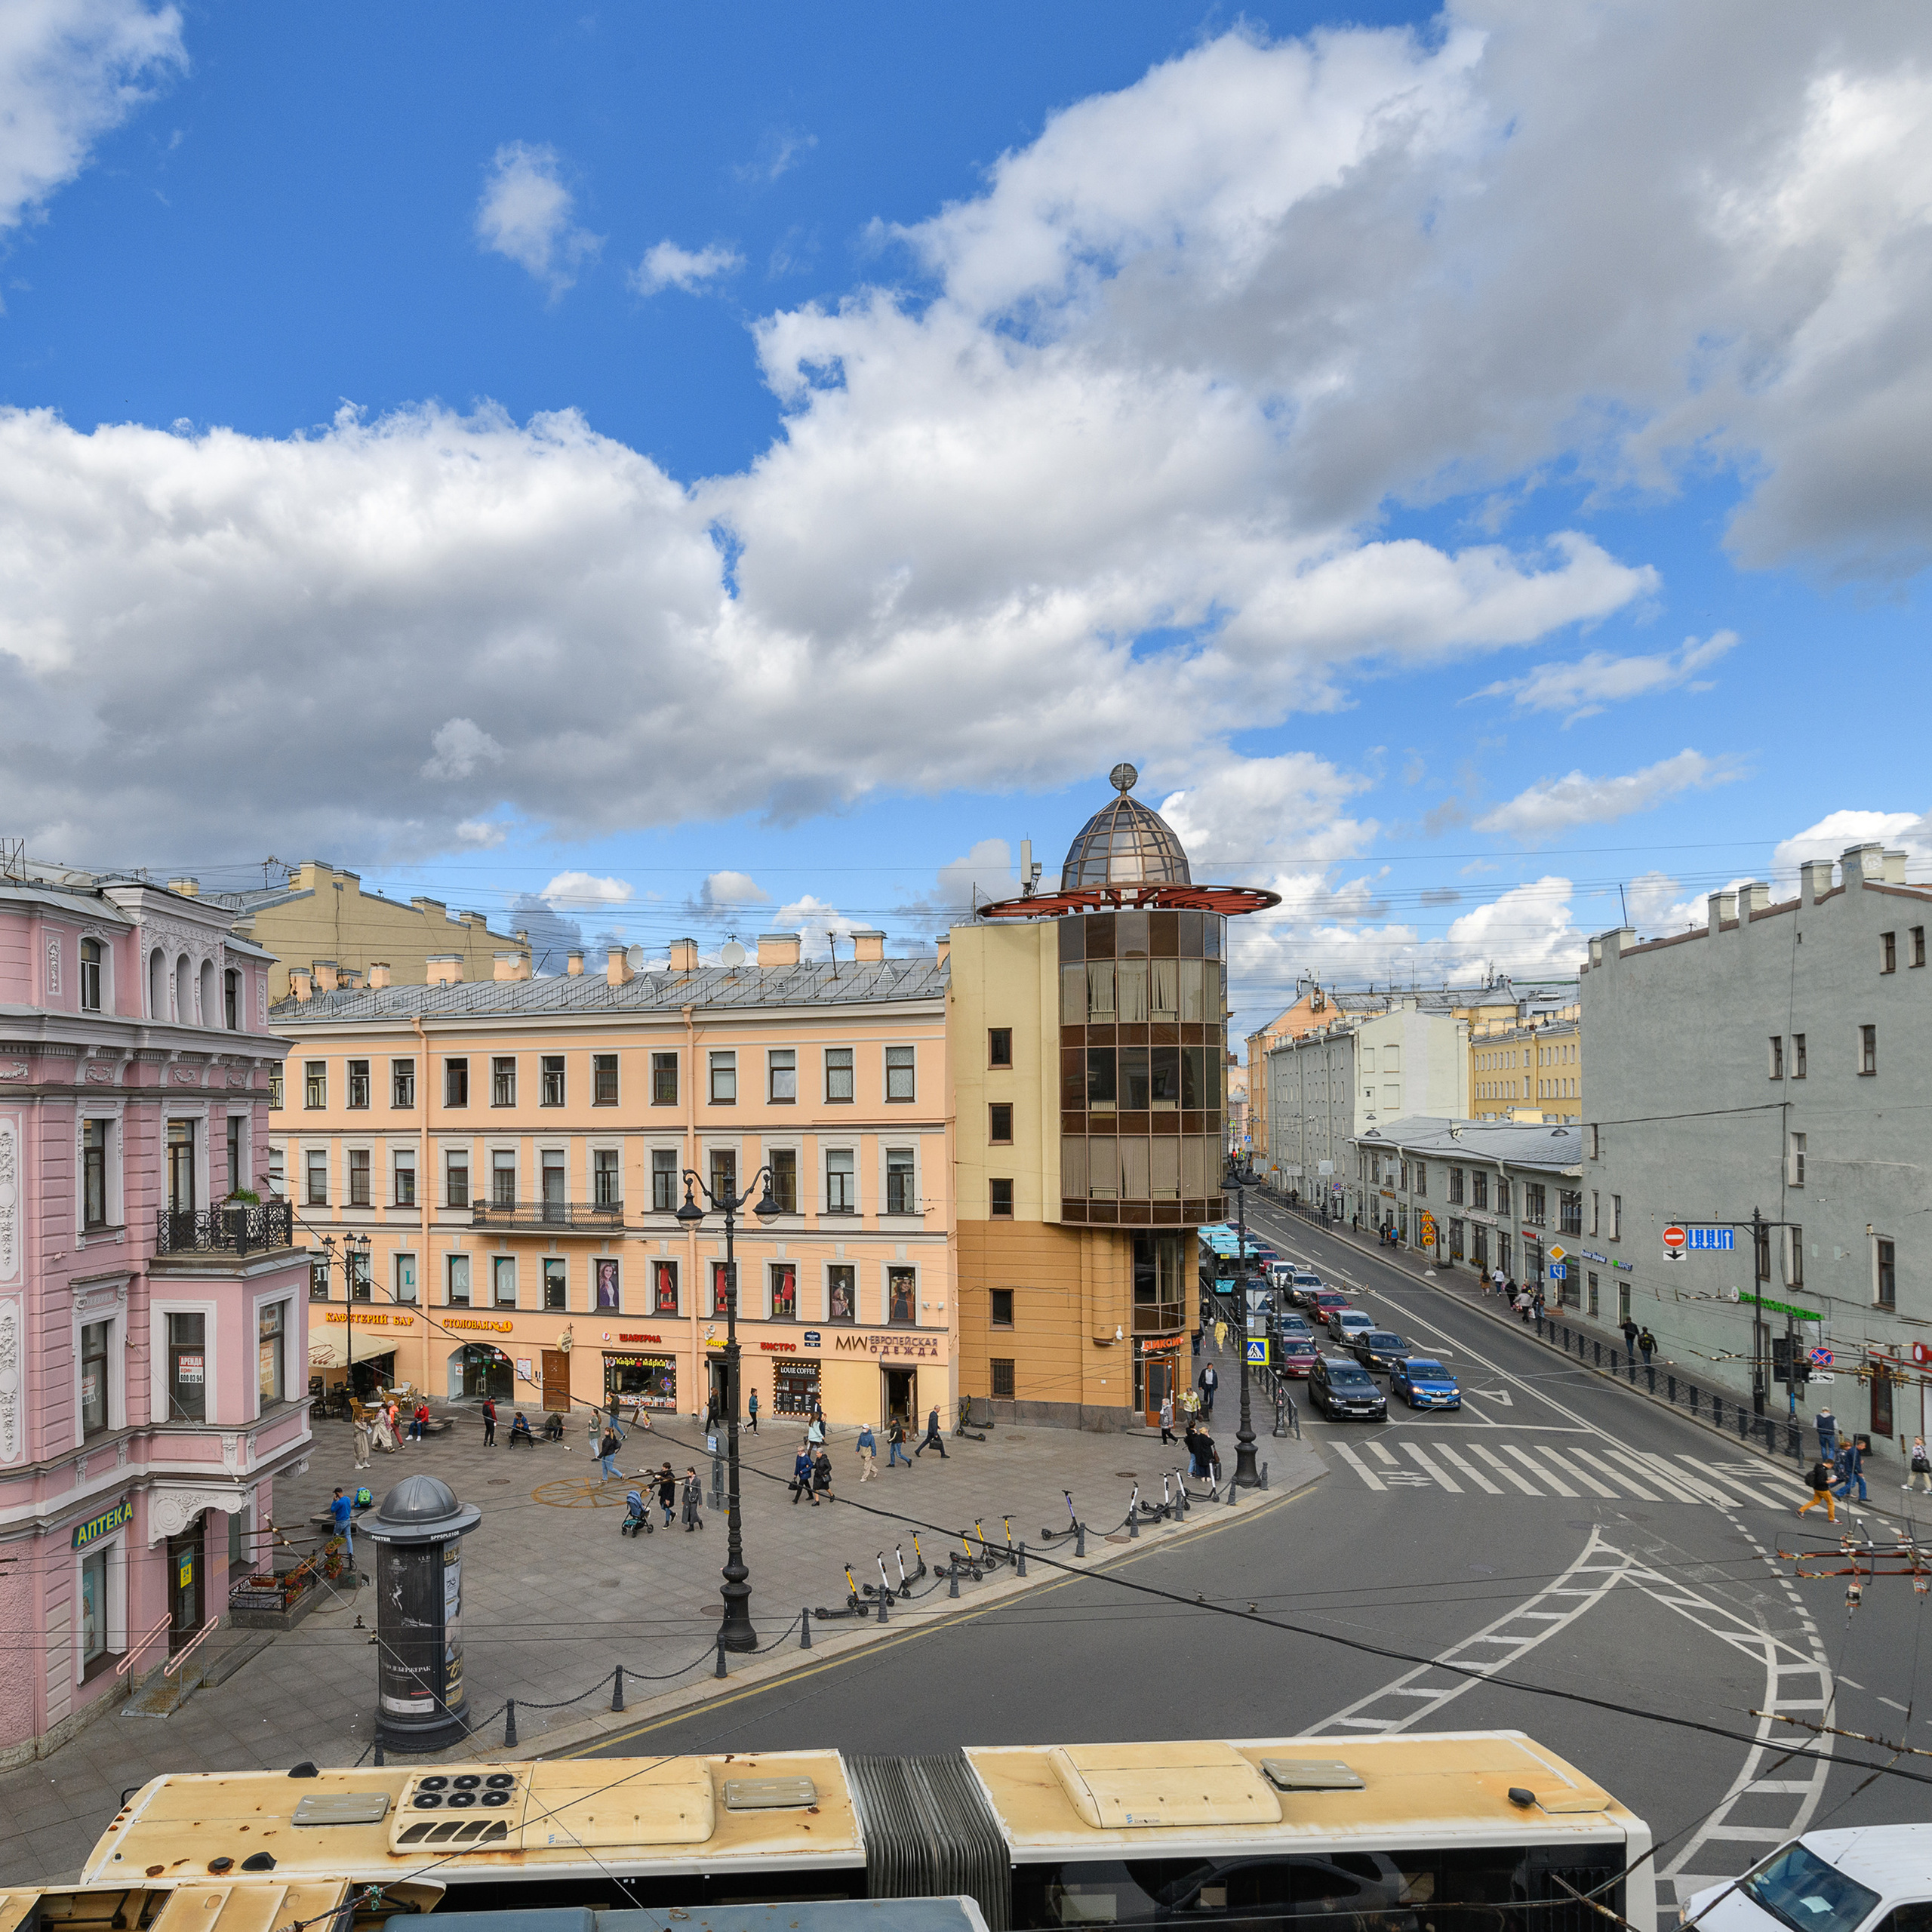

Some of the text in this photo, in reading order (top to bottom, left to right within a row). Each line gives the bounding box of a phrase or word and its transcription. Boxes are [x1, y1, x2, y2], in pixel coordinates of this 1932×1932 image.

[325, 1312, 414, 1326] КАФЕТЕРИЙ БАР
[442, 1318, 489, 1331] СТОЛОВАЯ
[619, 1333, 662, 1343] ШАВЕРМА
[835, 1335, 868, 1351] MW
[870, 1335, 938, 1347] ЕВРОПЕЙСКАЯ
[760, 1342, 797, 1352] БИСТРО
[870, 1346, 938, 1357] ОДЕЖДА
[181, 1357, 202, 1366] АРЕНДА
[616, 1358, 635, 1367] Кафе
[77, 1502, 133, 1546] АПТЕКА
